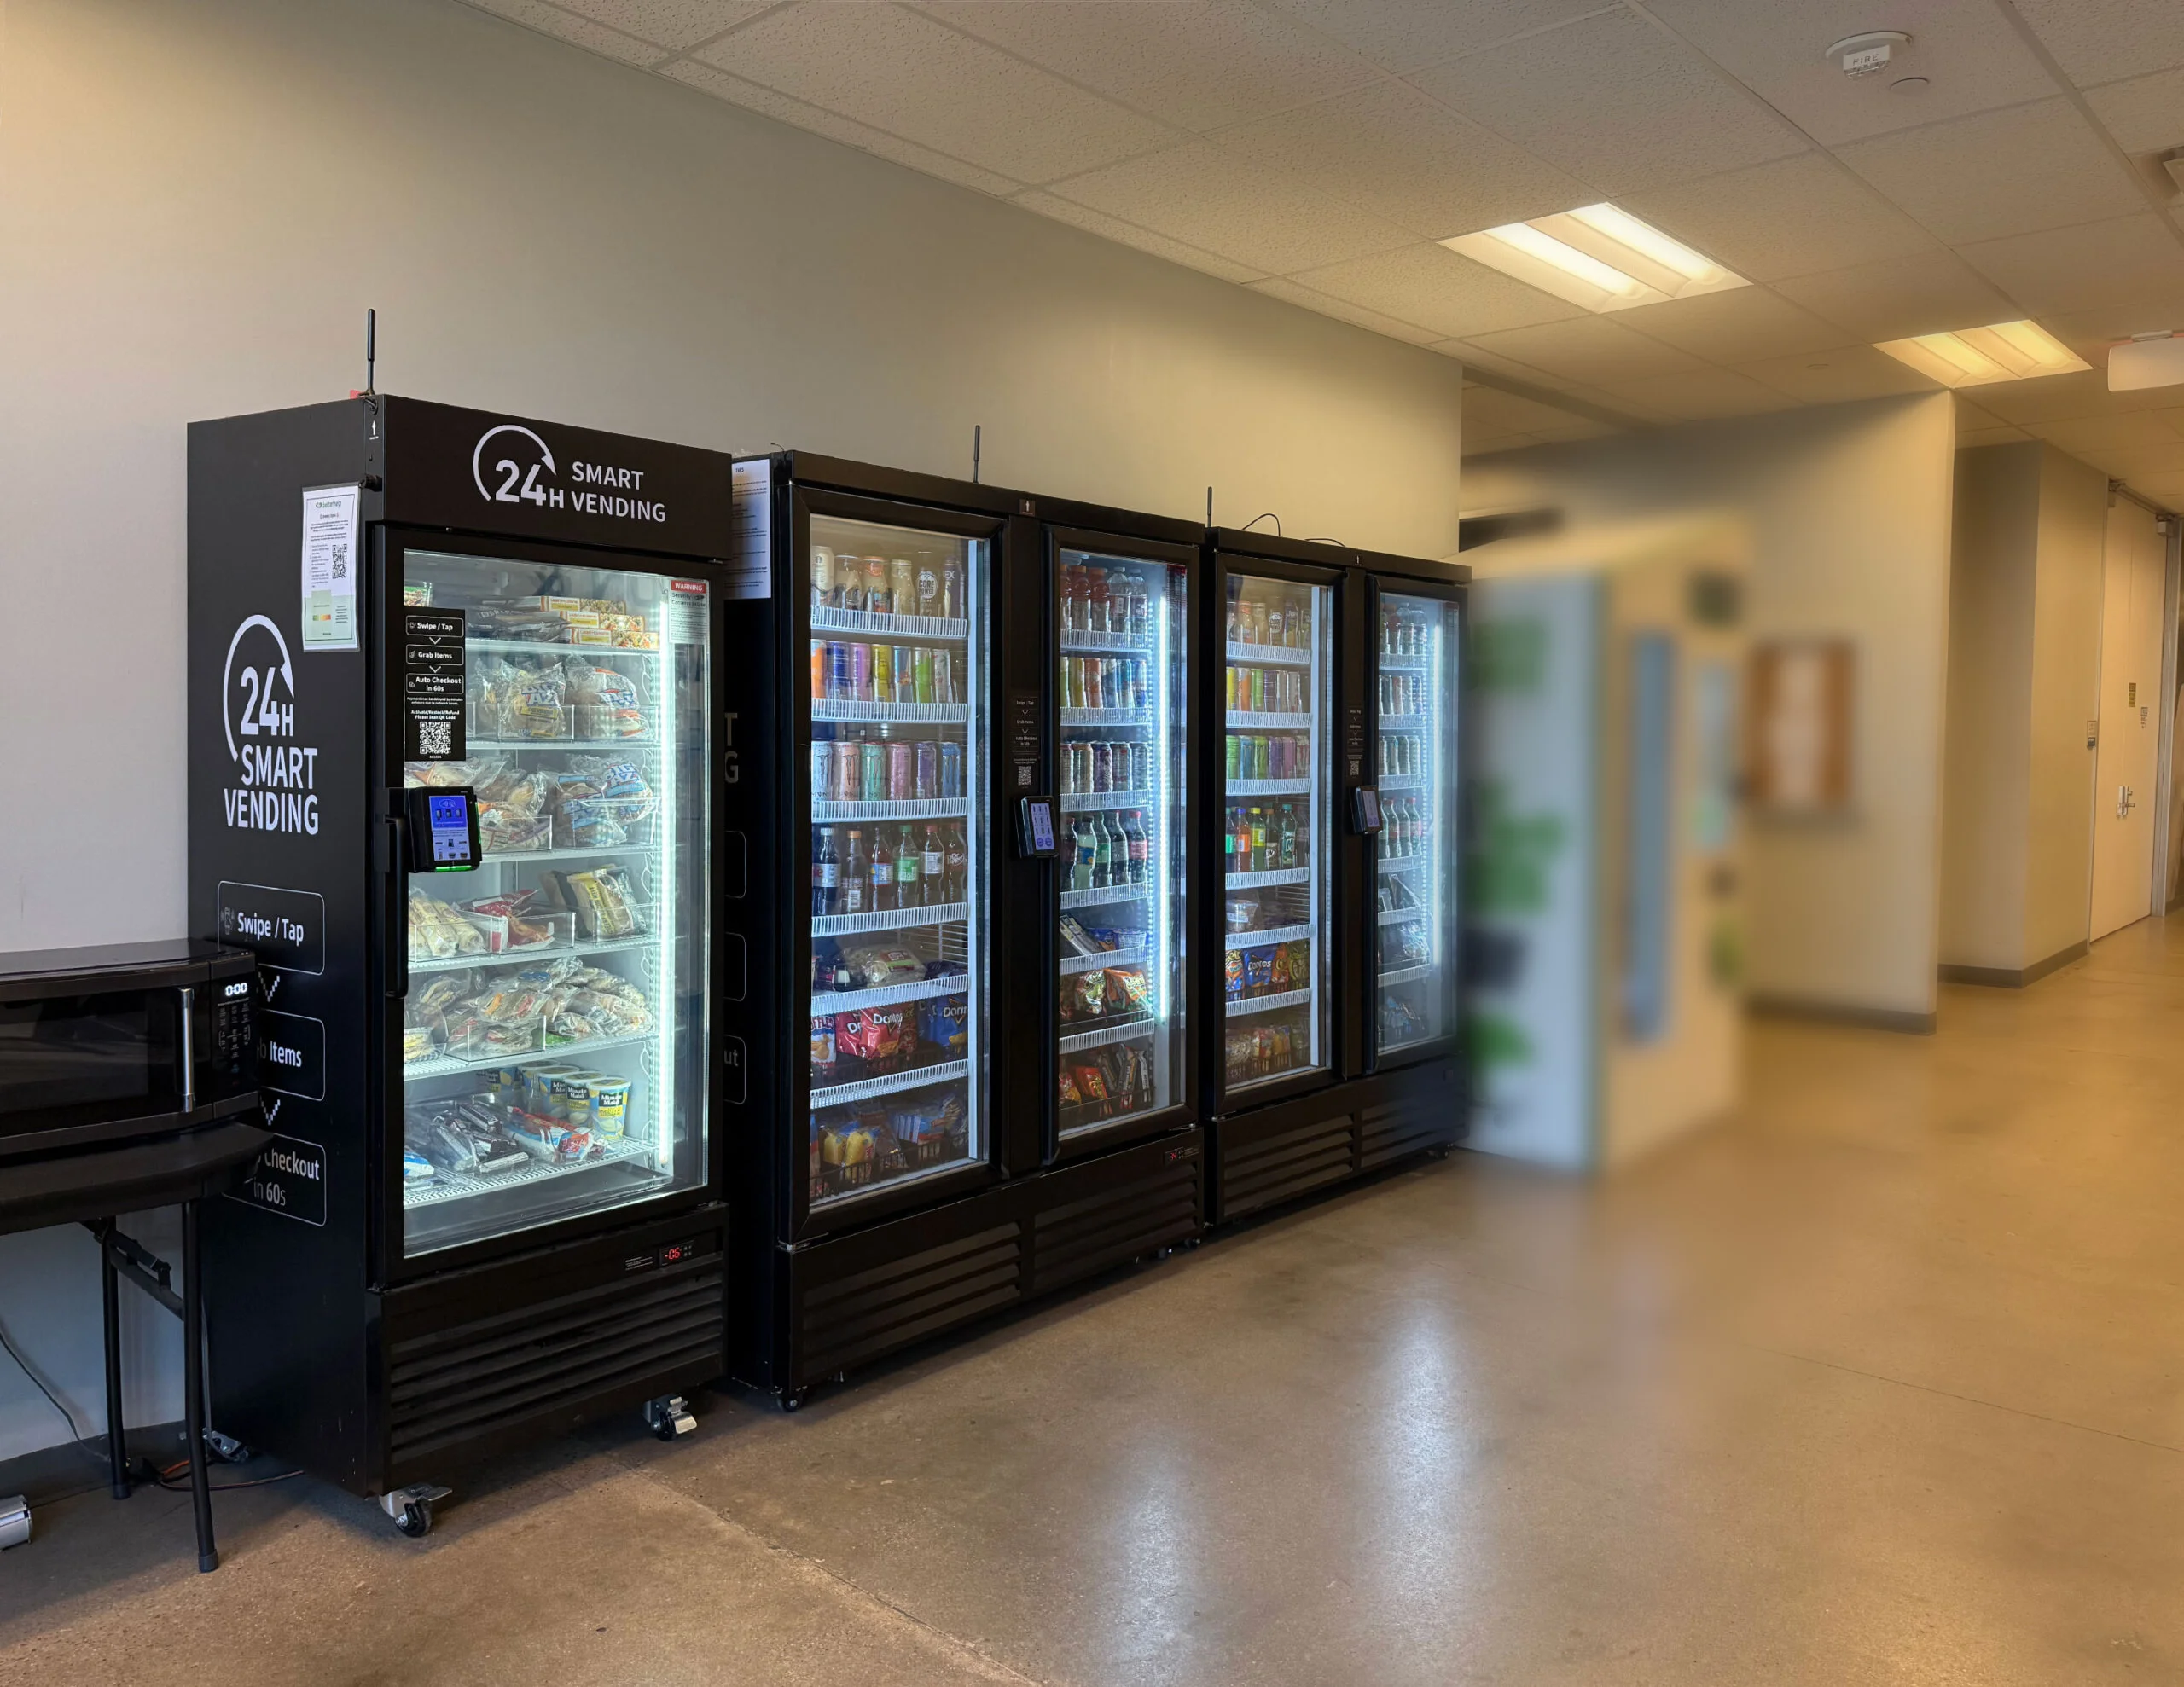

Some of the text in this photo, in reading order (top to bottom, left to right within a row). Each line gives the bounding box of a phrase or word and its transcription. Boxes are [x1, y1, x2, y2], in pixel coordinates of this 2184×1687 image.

[1853, 54, 1879, 66] FIRE
[496, 459, 564, 509] 24H
[572, 461, 644, 490] SMART
[571, 490, 666, 523] VENDING
[675, 583, 703, 591] WARNING
[918, 579, 934, 588] CORE
[417, 622, 436, 631] Swipe
[441, 623, 453, 632] Tap
[241, 666, 294, 737] 24H
[241, 744, 318, 790] SMART
[224, 788, 319, 836] VENDING
[237, 912, 304, 947] Swipe / Tap
[225, 982, 247, 996] 0:00
[270, 1041, 302, 1068] Items
[567, 1087, 588, 1095] Minute
[601, 1094, 622, 1103] Minute
[254, 1177, 286, 1206] in 60s
